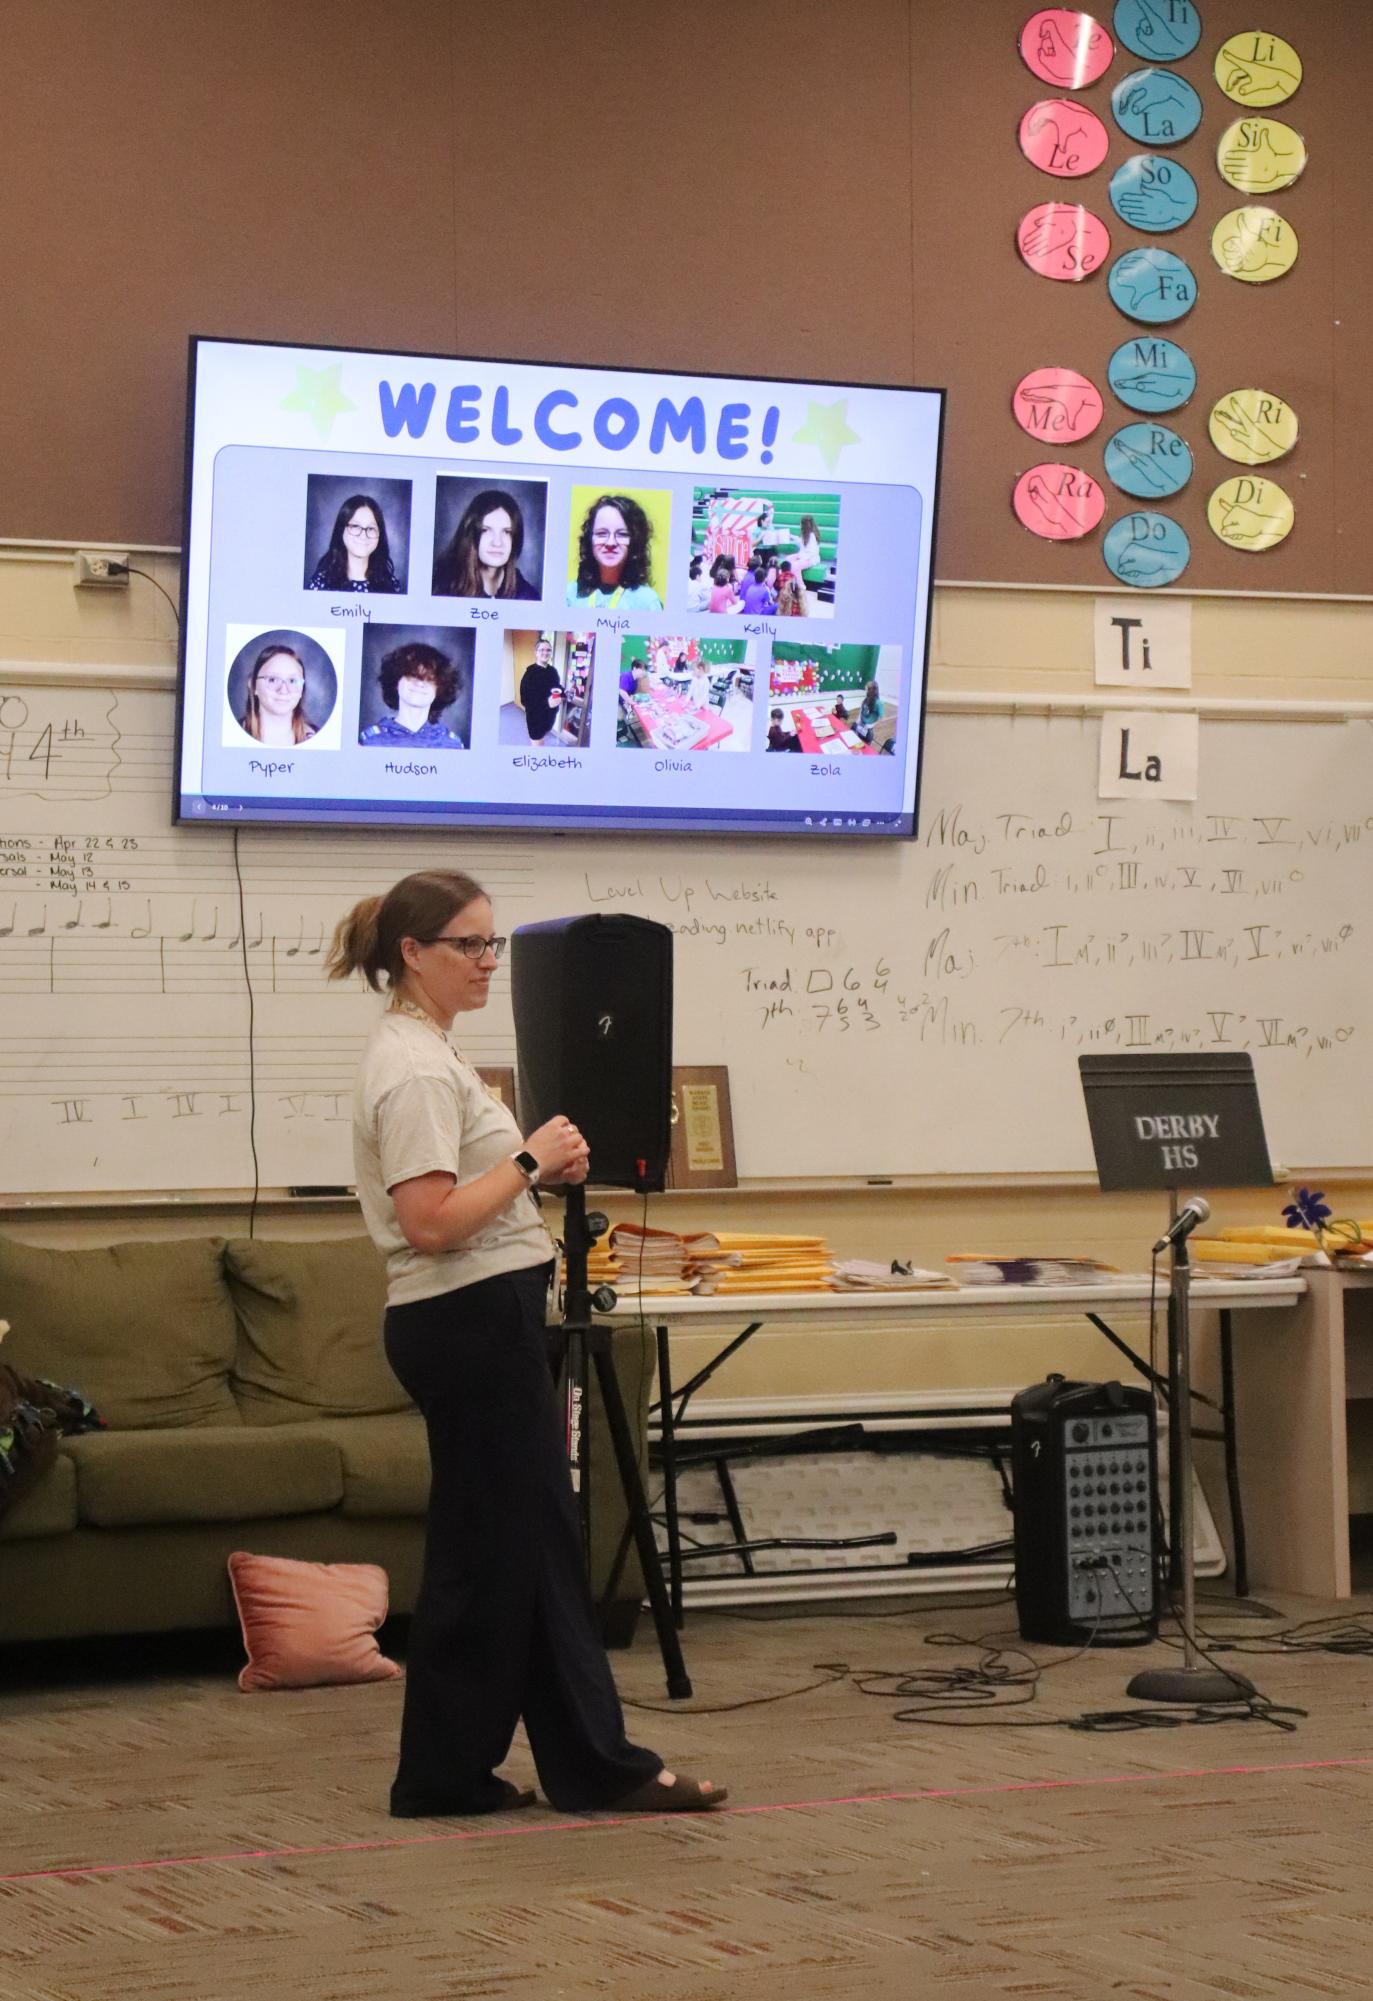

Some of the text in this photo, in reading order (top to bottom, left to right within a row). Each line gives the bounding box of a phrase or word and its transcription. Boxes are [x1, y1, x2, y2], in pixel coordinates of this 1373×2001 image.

[1252, 37, 1275, 62] Li
[1143, 112, 1176, 137] La
[1237, 122, 1259, 148] Si
[1047, 144, 1080, 170] Le
[1140, 158, 1172, 184] So
[1257, 217, 1282, 243] Fi
[1061, 245, 1095, 271] Se
[1157, 275, 1190, 301] Fa
[1133, 342, 1167, 369] Mi
[378, 379, 780, 465] WELCOME!
[1026, 404, 1066, 431] Me
[1255, 399, 1283, 425] Ri
[1150, 430, 1182, 457] Re
[1056, 472, 1093, 498] Ra
[1233, 479, 1264, 505] Di
[1130, 515, 1167, 542] Do
[330, 604, 372, 624] Emily
[470, 607, 499, 621] Zoe
[597, 617, 631, 633] Myia
[743, 622, 778, 639] Kelly
[1109, 616, 1152, 671] Ti
[512, 755, 582, 773] Elizabeth
[654, 759, 693, 773] Olivia
[1118, 727, 1162, 782] La
[249, 760, 295, 778] Pyper
[384, 761, 438, 776] Hudson
[809, 763, 841, 777] Zola
[995, 811, 1073, 841] Triad
[54, 835, 77, 853] Apr
[85, 837, 100, 849] 22
[121, 839, 138, 850] 23
[49, 852, 76, 868] May
[83, 852, 94, 863] 12
[49, 866, 76, 882] May
[81, 866, 94, 878] 13
[990, 864, 1049, 895] Triad
[49, 880, 77, 896] May
[85, 881, 97, 892] 14
[117, 881, 131, 892] 15
[584, 871, 644, 901] Level
[659, 876, 694, 912] Up
[741, 967, 792, 993] Triad
[1133, 1113, 1220, 1140] DERBY
[1160, 1144, 1199, 1170] HS
